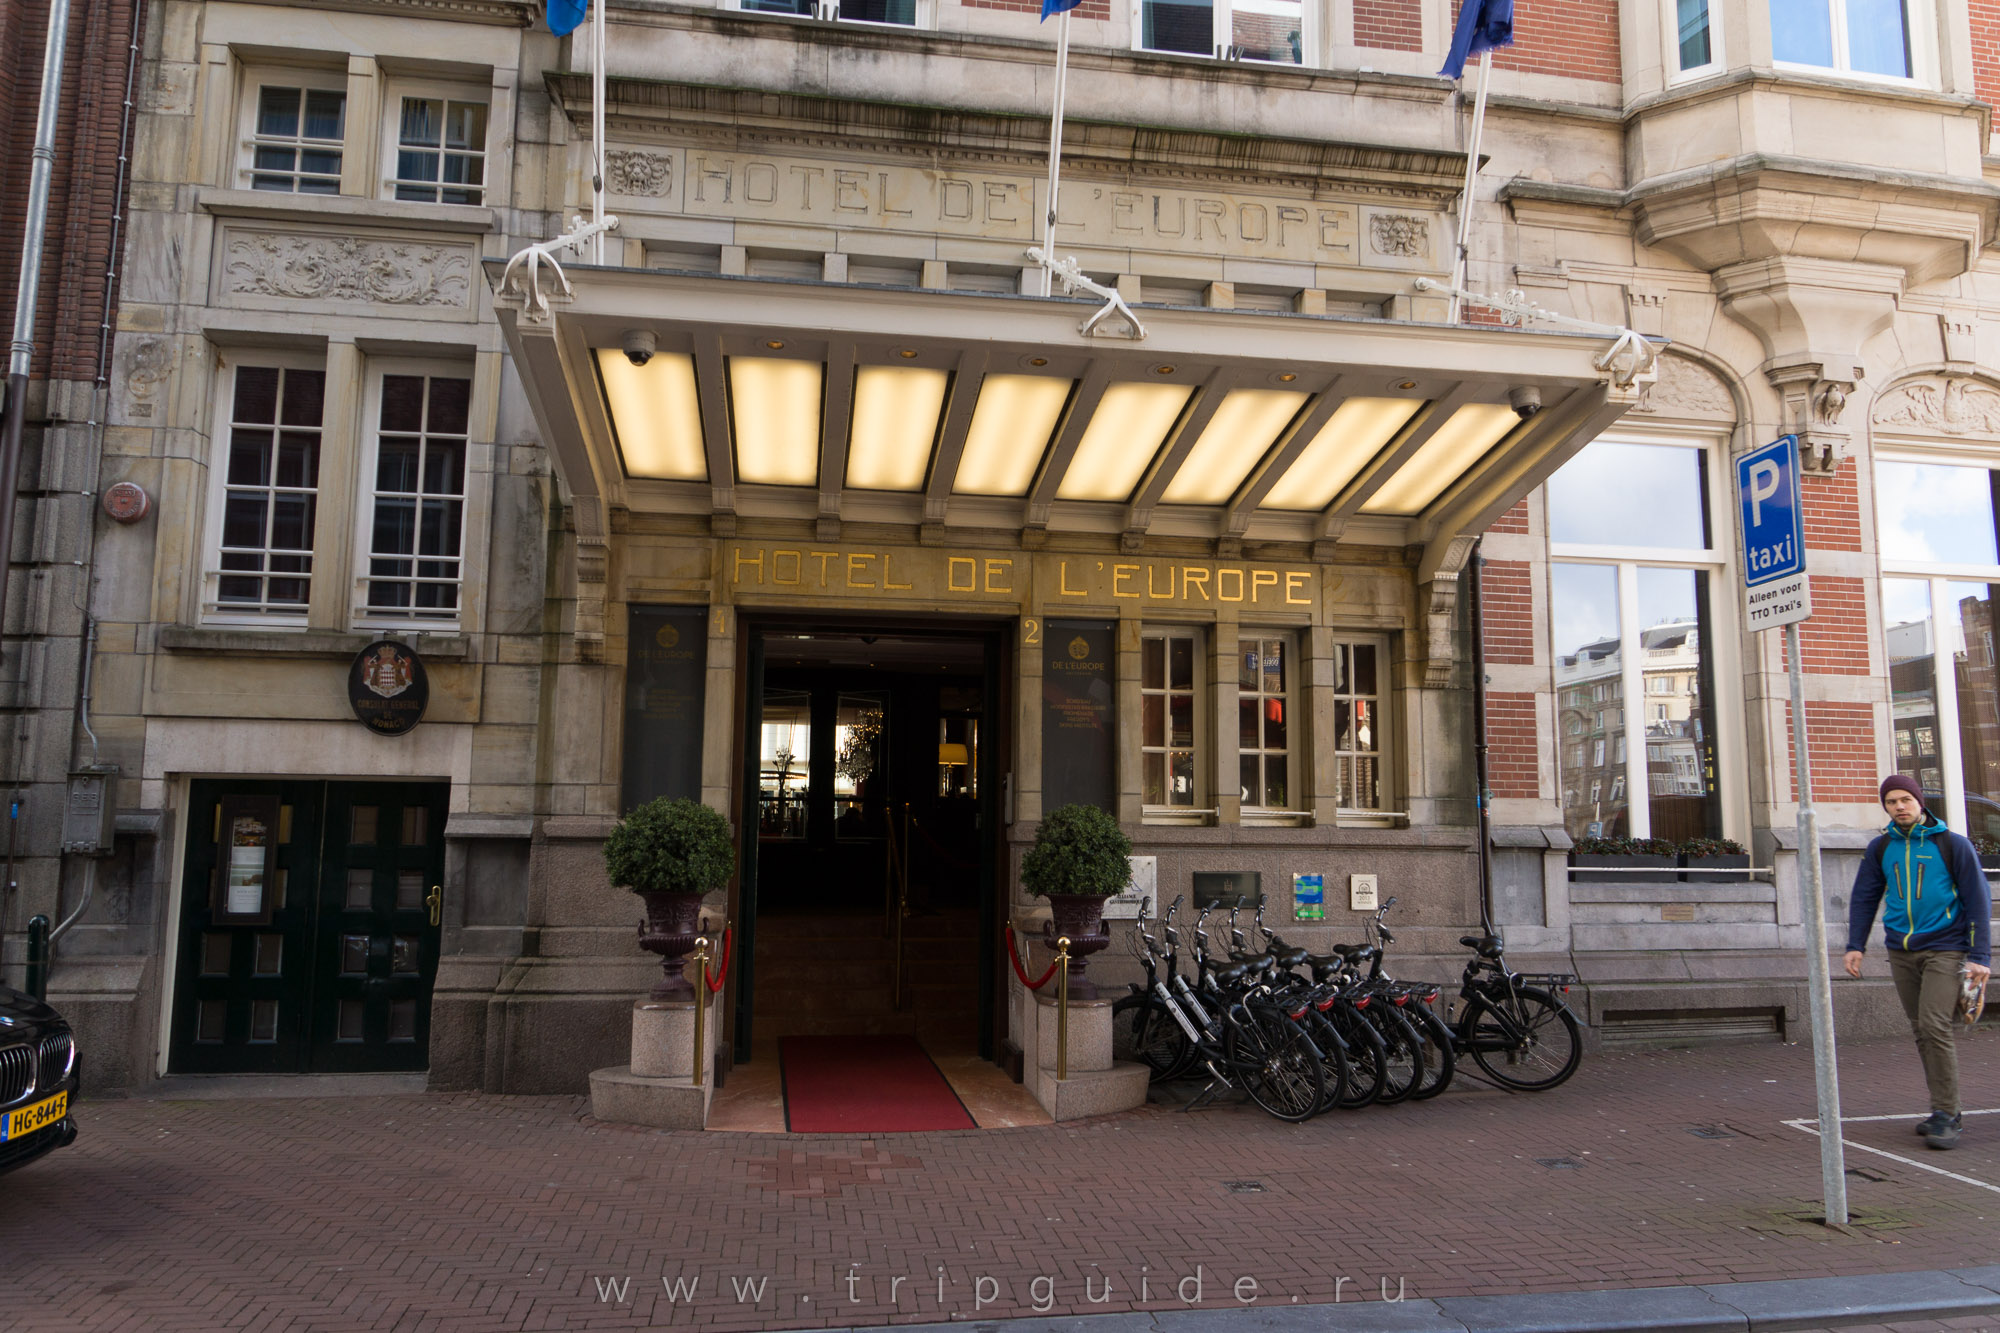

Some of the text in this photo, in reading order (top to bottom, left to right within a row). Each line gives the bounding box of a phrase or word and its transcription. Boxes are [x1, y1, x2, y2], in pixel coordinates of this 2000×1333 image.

[695, 157, 1350, 253] HOTEL DE L'EUROPE
[1749, 458, 1780, 528] P
[1750, 534, 1792, 572] taxi
[733, 547, 1312, 605] HOTEL DE L'EUROPE
[1749, 582, 1802, 605] Alleen voor
[1772, 600, 1802, 615] Taxi's
[1024, 619, 1040, 644] 2
[1052, 661, 1105, 671] DE L'EUROPE
